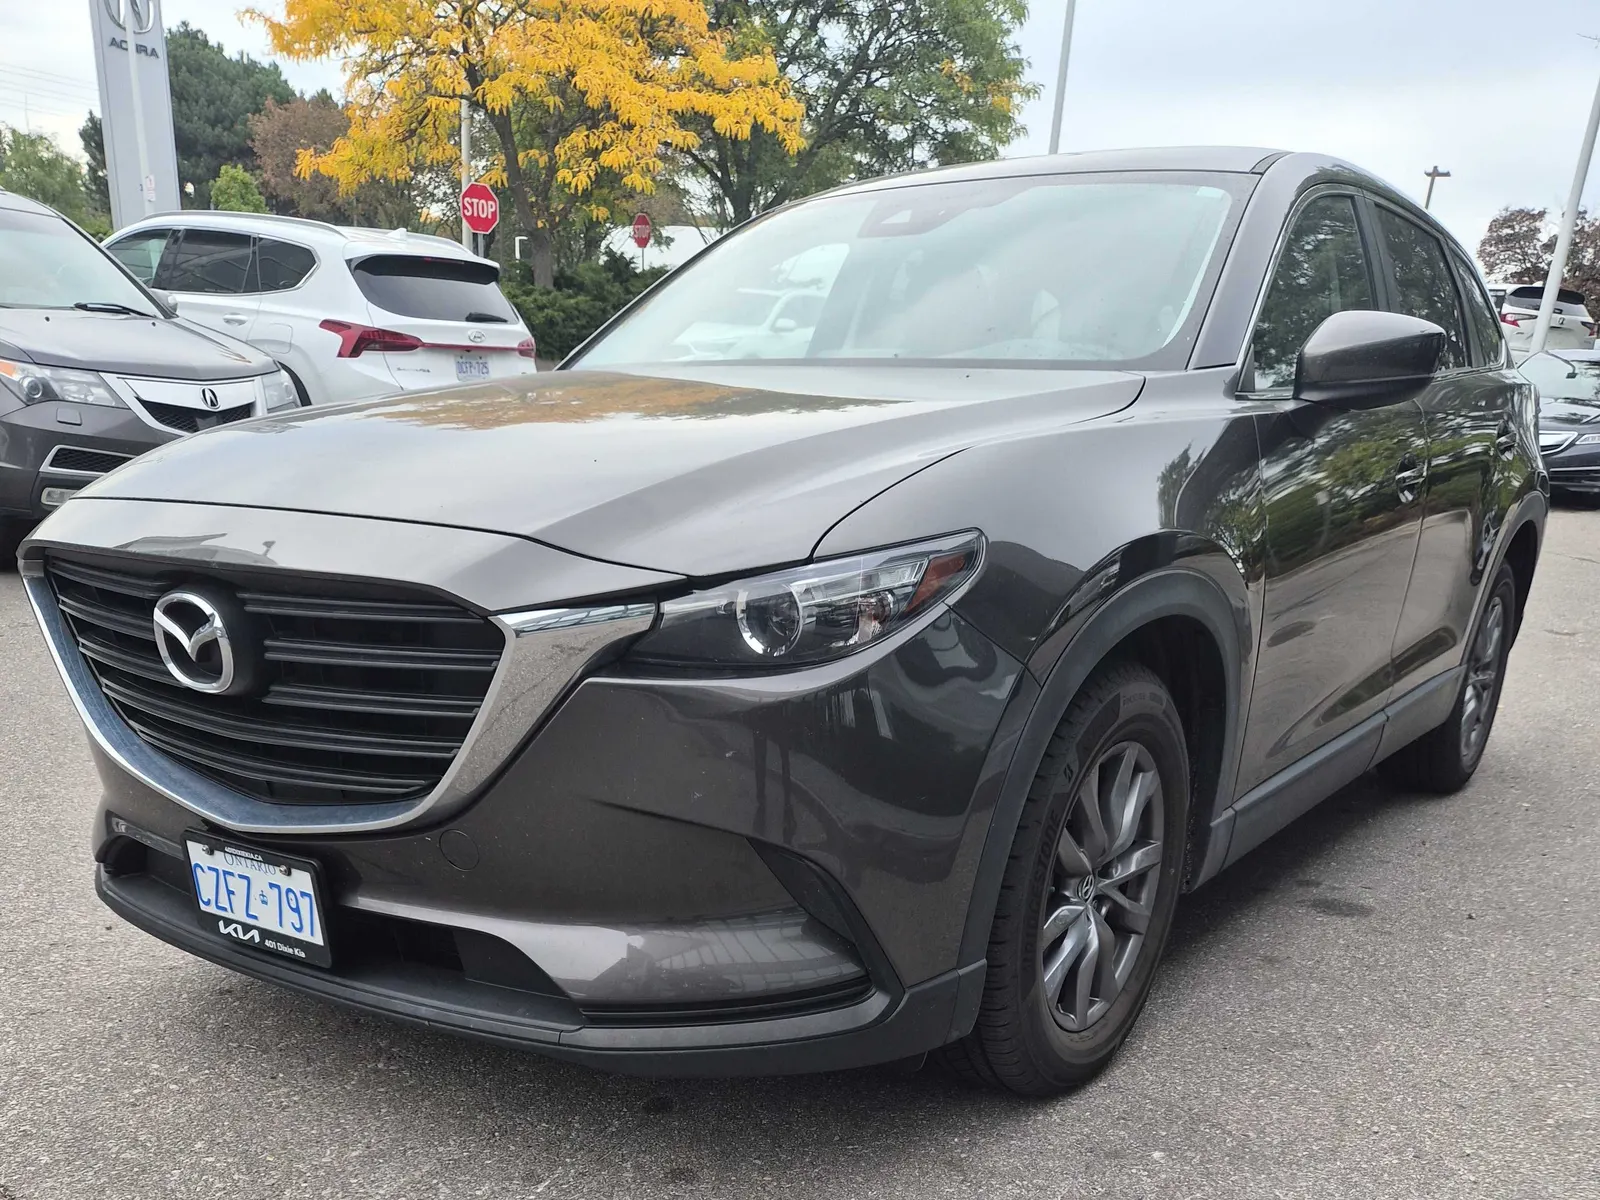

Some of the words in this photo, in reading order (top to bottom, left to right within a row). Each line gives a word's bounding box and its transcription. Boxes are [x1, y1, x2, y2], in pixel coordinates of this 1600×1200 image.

[109, 37, 160, 59] ACRA
[463, 197, 496, 219] STOP
[224, 852, 276, 876] ONTARIO
[192, 862, 260, 921] CZFZ
[268, 882, 315, 938] 797
[264, 939, 277, 950] 401
[293, 948, 306, 958] Kia
